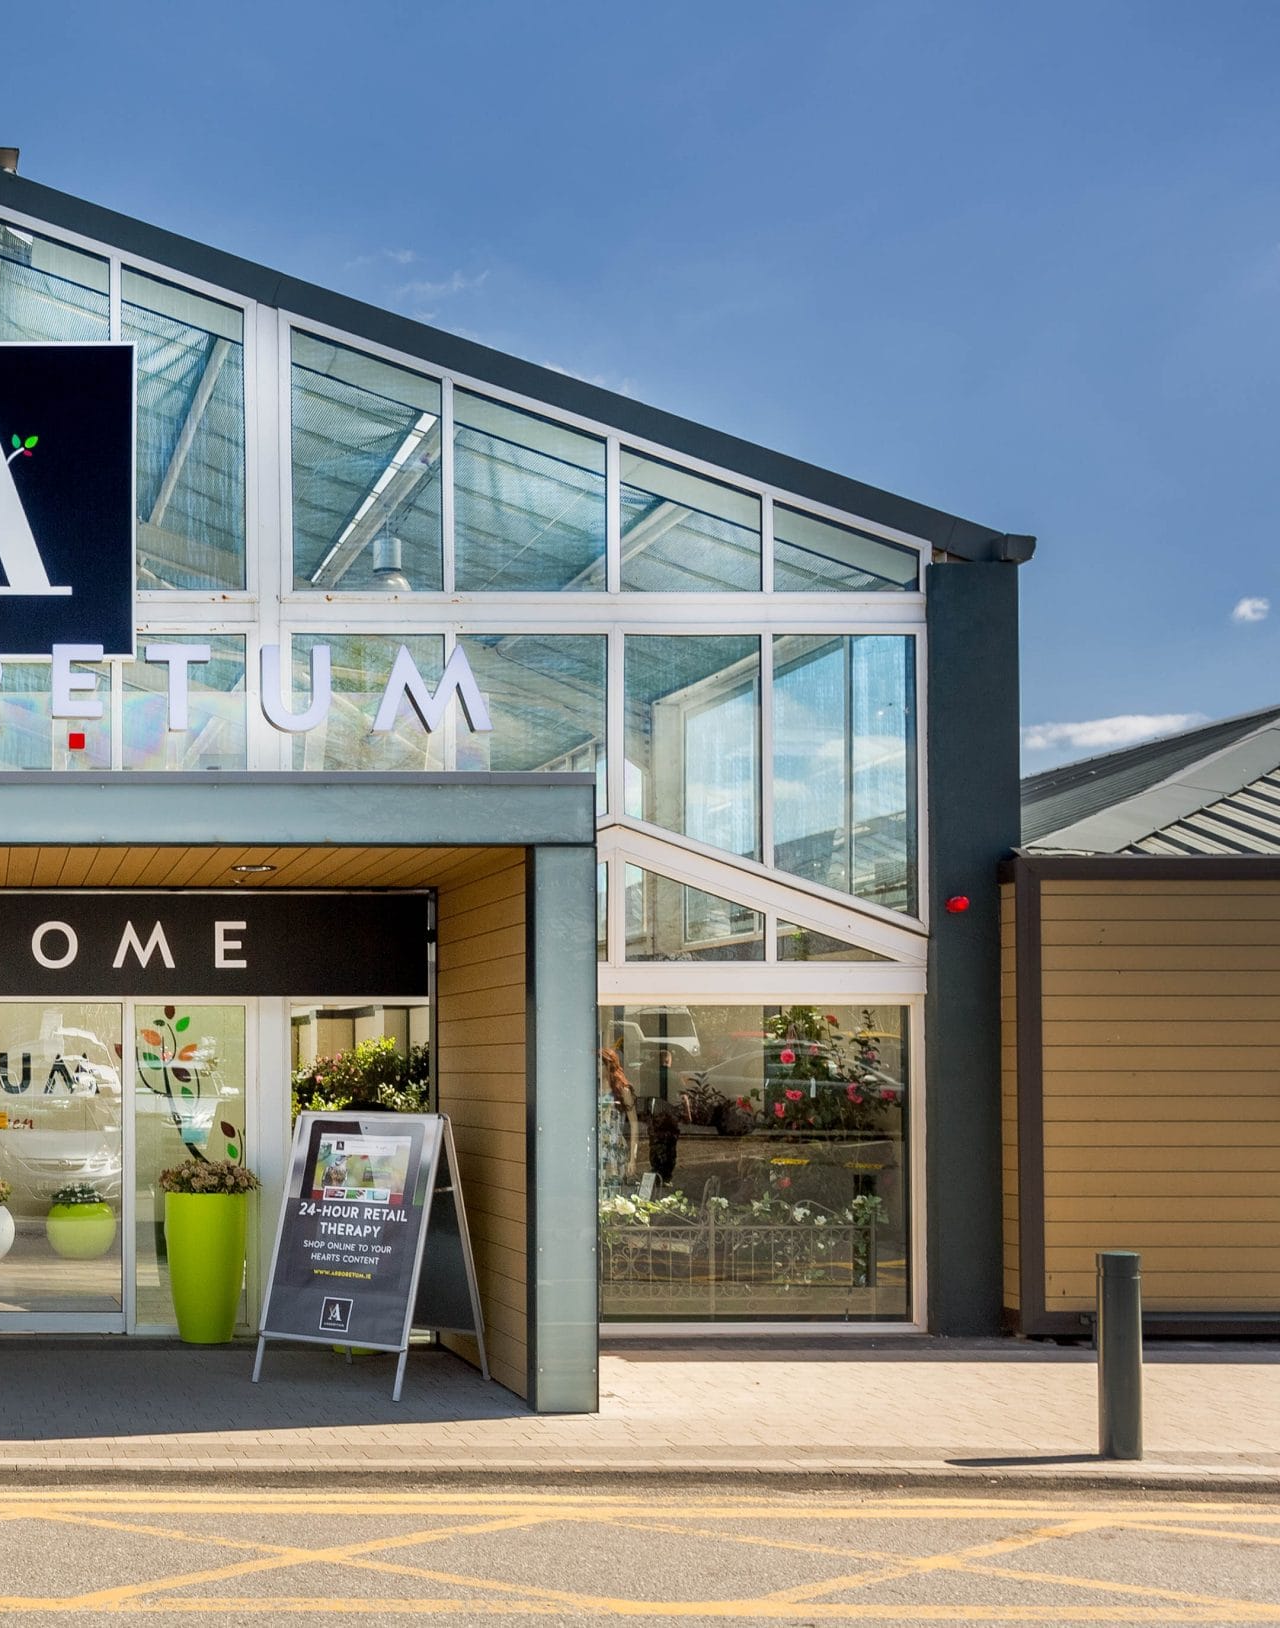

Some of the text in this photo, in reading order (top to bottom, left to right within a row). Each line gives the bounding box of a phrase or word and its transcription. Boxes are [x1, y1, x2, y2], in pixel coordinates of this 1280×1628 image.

[298, 1202, 408, 1223] 24-HOUR RETAIL
[320, 1221, 381, 1238] THERAPY
[303, 1240, 392, 1254] SHOP ONLINE TO YOUR
[310, 1252, 380, 1265] HEARTS CONTENT
